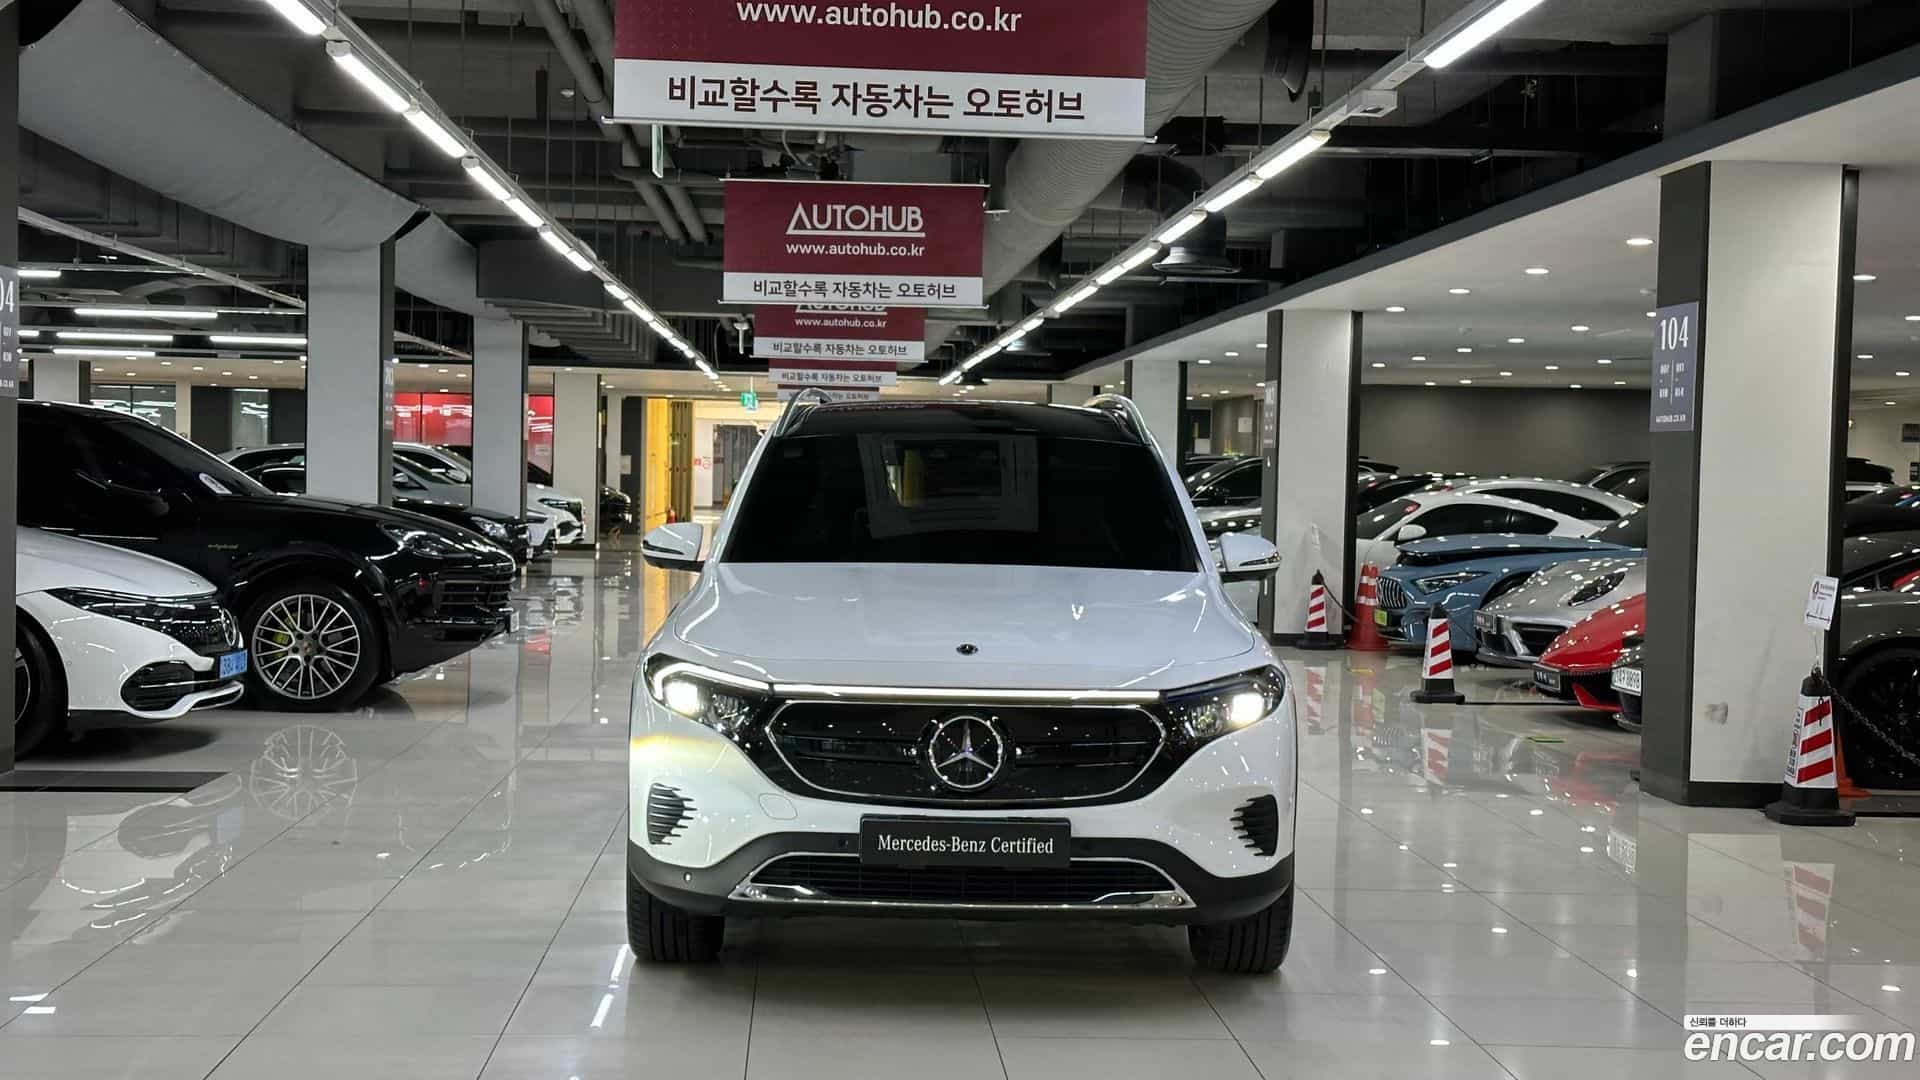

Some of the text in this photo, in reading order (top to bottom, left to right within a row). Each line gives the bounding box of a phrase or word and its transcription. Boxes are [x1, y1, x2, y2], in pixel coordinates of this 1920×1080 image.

[736, 2, 1022, 32] www.autohub.co.kr
[668, 75, 1085, 123] 비교할수록 자동차는 오토허브
[786, 202, 925, 236] AUTOHUB
[786, 243, 926, 257] www.autohub.co.kr
[754, 279, 956, 300] 비교할수록 자동차는 오토허브
[794, 317, 888, 328] www.autohub.co.kr
[1660, 316, 1689, 351] 104
[773, 341, 908, 357] 비교할수록 자동차는 오토허브
[877, 834, 1054, 854] Mercedes-Benz Certified
